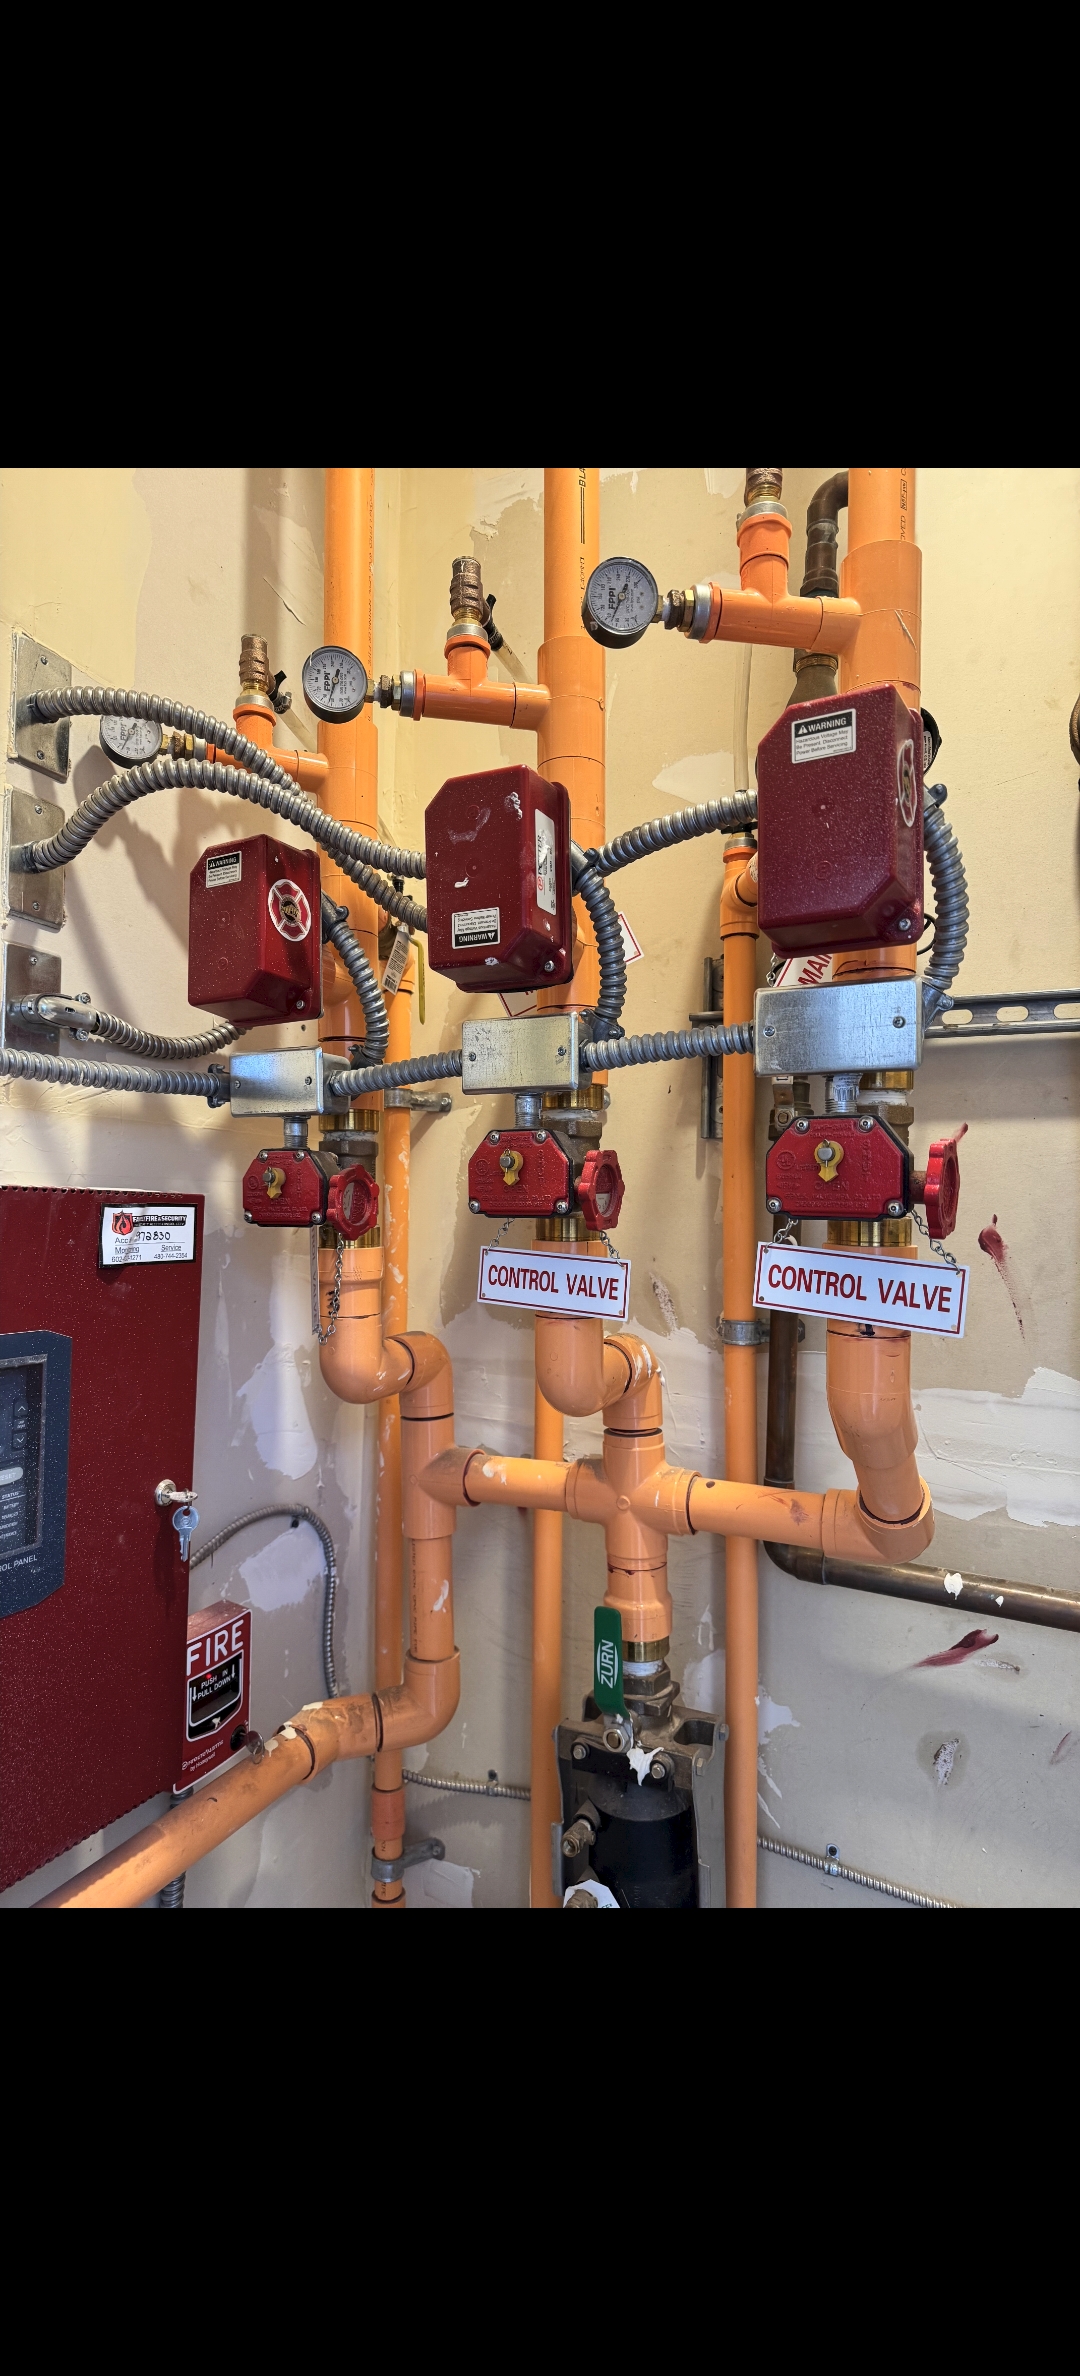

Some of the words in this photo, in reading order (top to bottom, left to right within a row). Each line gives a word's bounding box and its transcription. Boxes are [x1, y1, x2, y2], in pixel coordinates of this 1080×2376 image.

[808, 718, 847, 732] WARNING
[459, 933, 488, 943] WARNING
[797, 954, 833, 984] MAI
[161, 1244, 182, 1252] Service
[487, 1264, 559, 1294] CONTROL
[566, 1273, 619, 1301] VALVE
[767, 1263, 868, 1302] CONTROL
[878, 1277, 953, 1313] VALVE
[14, 1555, 38, 1568] PANEL
[186, 1620, 244, 1677] FIRE
[600, 1638, 614, 1689] ZURN
[197, 1687, 214, 1701] PULL
[214, 1676, 232, 1691] DOWN
[201, 1675, 218, 1689] PUSH
[222, 1668, 229, 1677] IN
